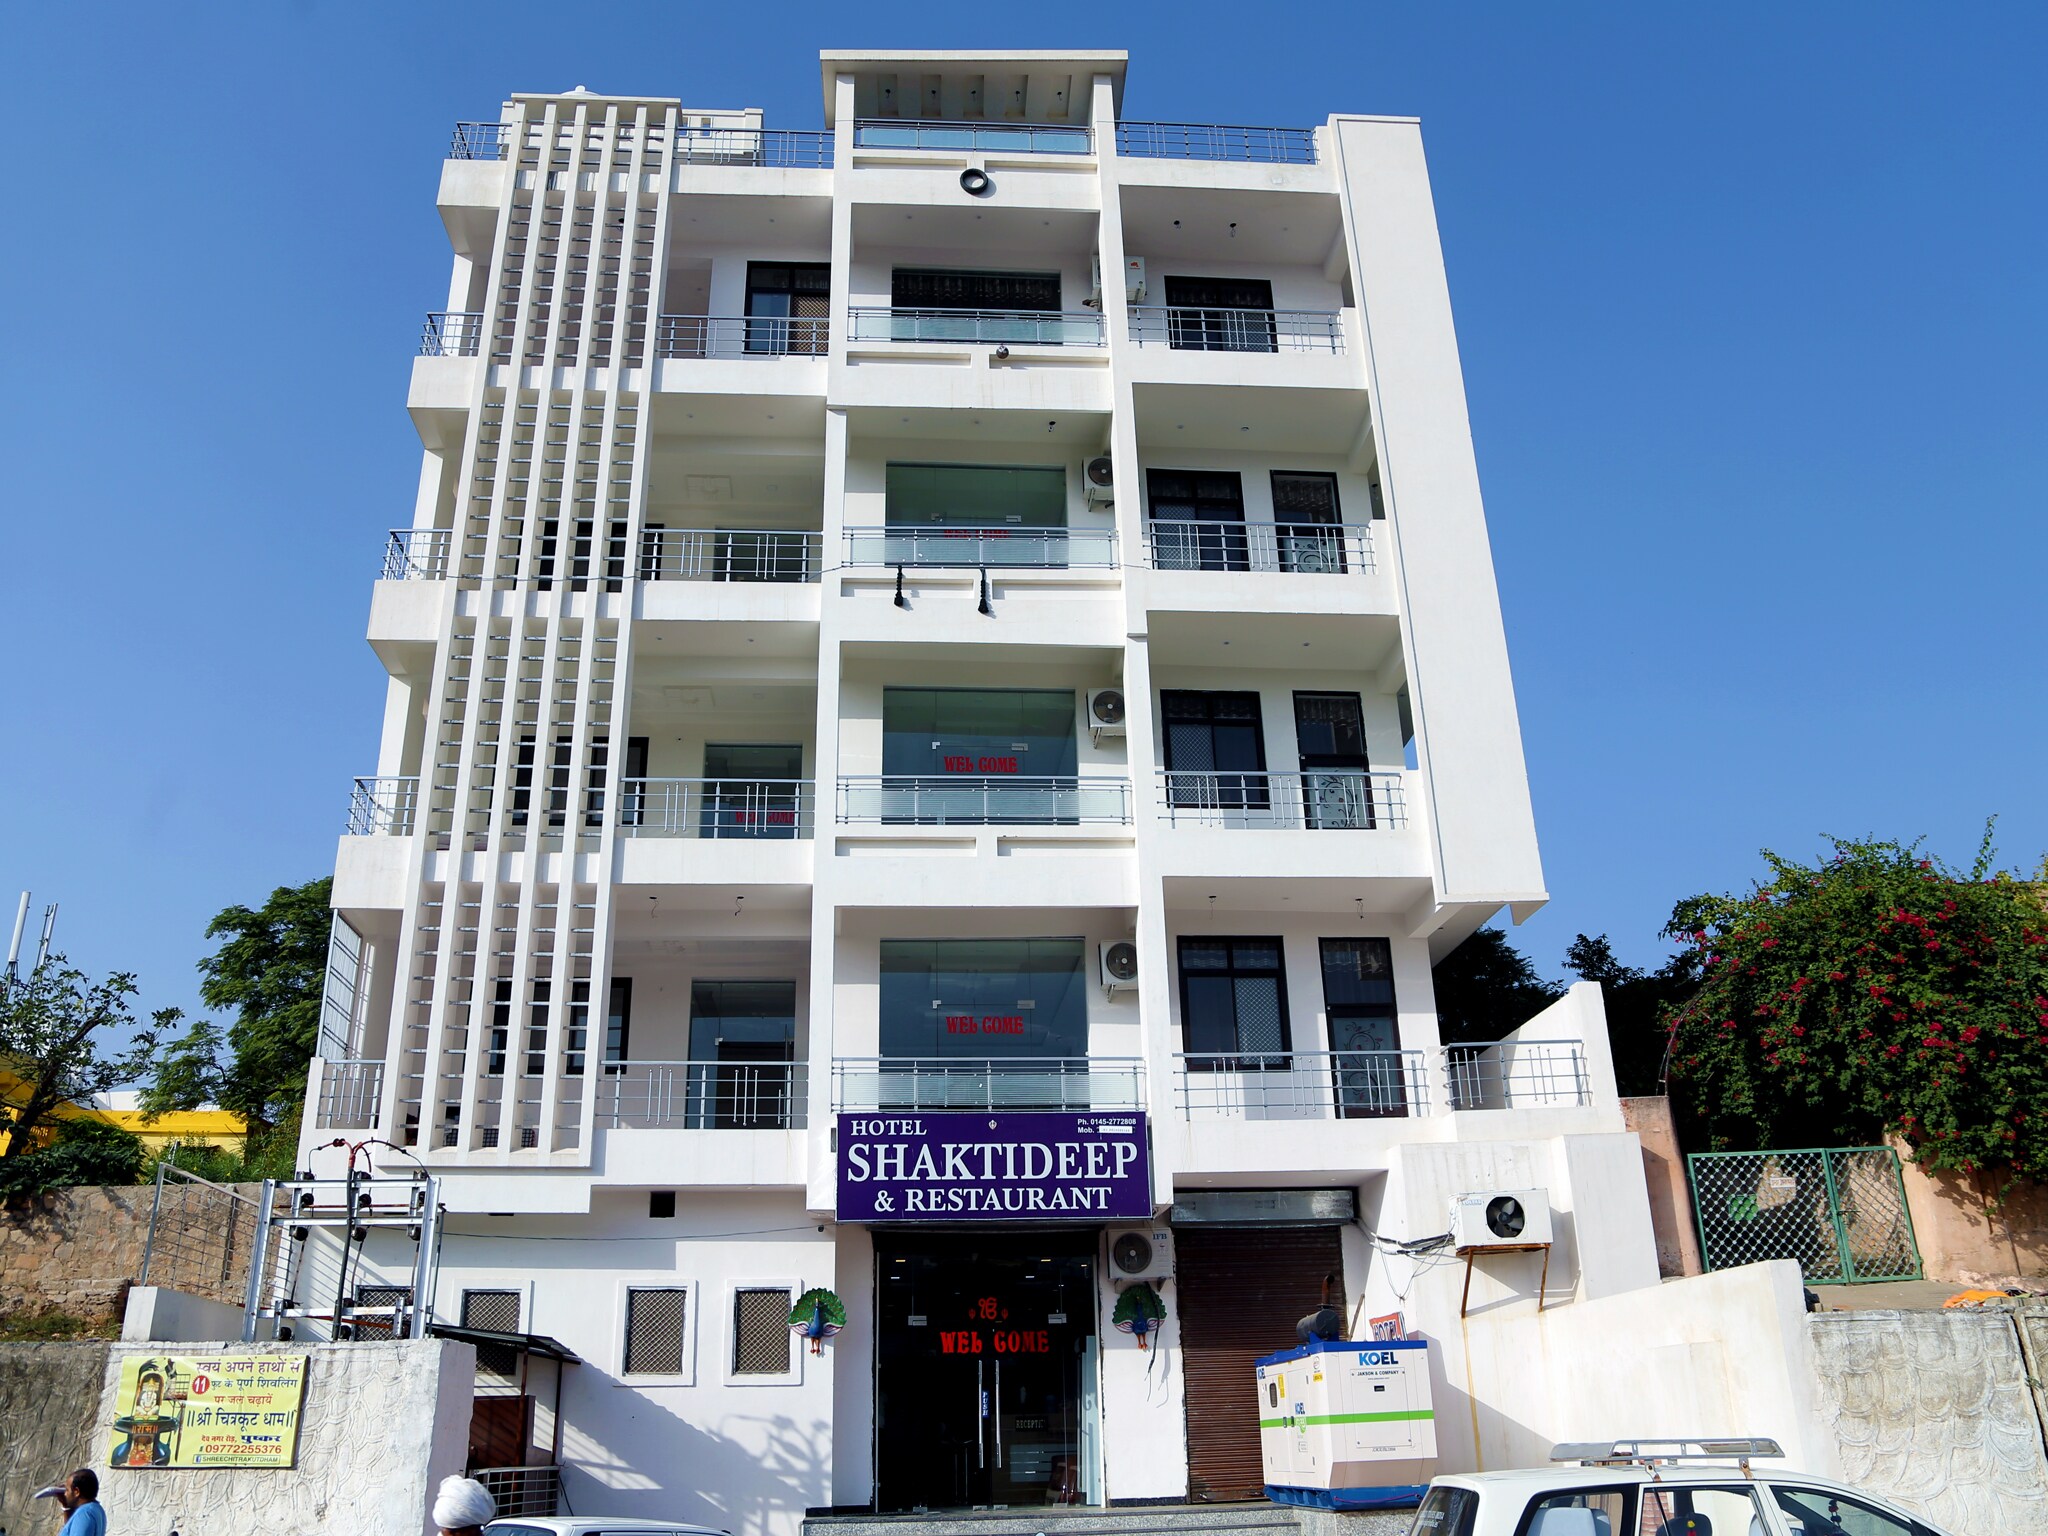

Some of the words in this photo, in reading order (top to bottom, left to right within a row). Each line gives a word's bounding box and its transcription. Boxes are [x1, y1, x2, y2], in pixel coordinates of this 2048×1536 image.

[944, 755, 974, 773] WEL
[978, 756, 1018, 773] COME
[945, 1016, 978, 1034] WEL
[982, 1016, 1024, 1034] COME
[850, 1120, 928, 1136] HOTEL
[1077, 1126, 1095, 1134] Mob.
[847, 1142, 1138, 1182] SHAKTIDEEP
[874, 1190, 896, 1212] &
[904, 1187, 1112, 1212] RESTAURANT
[940, 1331, 983, 1354] WEL
[993, 1330, 1049, 1353] COME
[196, 1359, 222, 1373] स्वयं
[225, 1358, 254, 1373] अपने
[258, 1356, 287, 1374] हाथों
[290, 1357, 302, 1373] से
[1358, 1351, 1399, 1366] KOEL
[194, 1377, 206, 1392] 11
[224, 1378, 233, 1388] के
[214, 1396, 225, 1404] पर
[1015, 1419, 1046, 1429] RECEPTI
[205, 1445, 282, 1454] 09772255376
